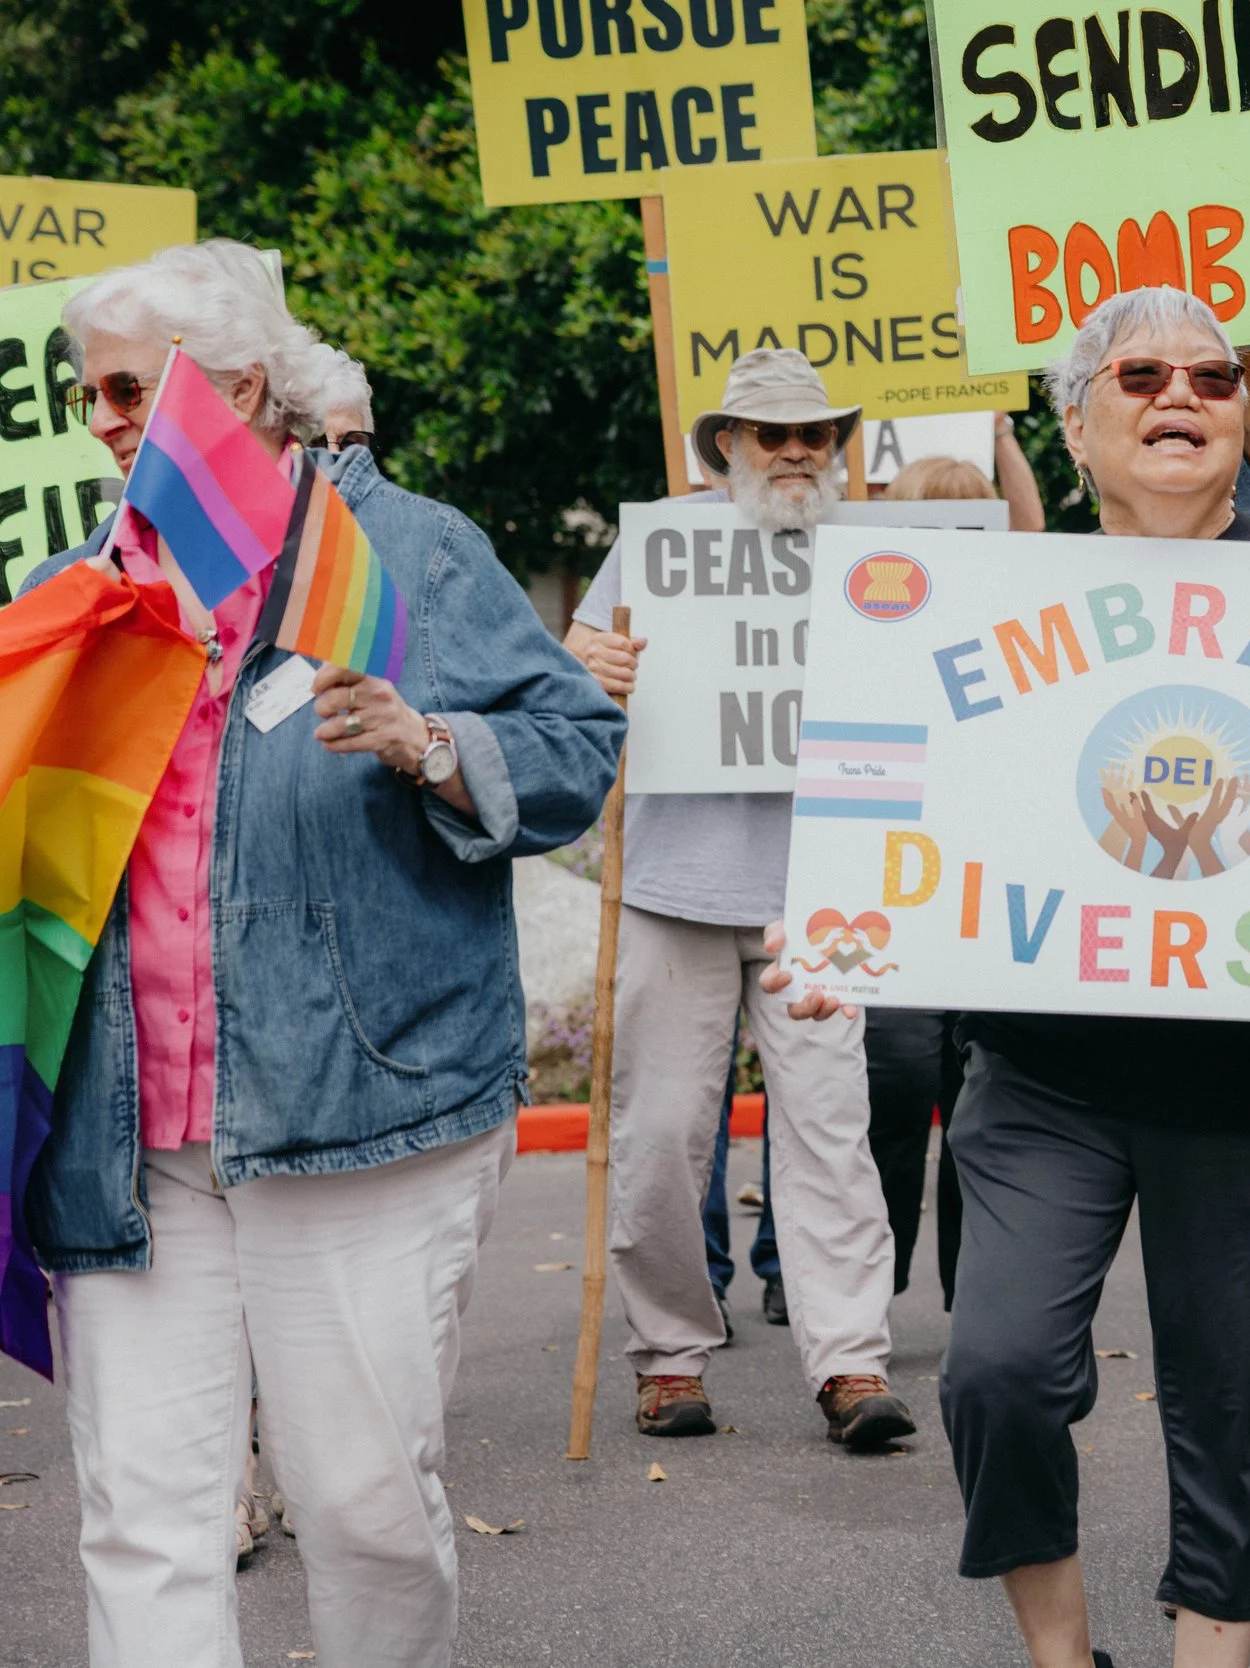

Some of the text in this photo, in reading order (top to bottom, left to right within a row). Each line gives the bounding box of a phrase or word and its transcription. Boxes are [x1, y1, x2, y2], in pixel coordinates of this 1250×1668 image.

[486, 0, 780, 63] PURSUE
[524, 83, 762, 178] PEACE
[754, 182, 917, 238] WAR
[813, 252, 869, 302] IS
[936, 380, 1010, 400] FRANCIS
[735, 620, 779, 667] In
[838, 762, 887, 776] Trans Pride
[1143, 755, 1214, 787] DEI
